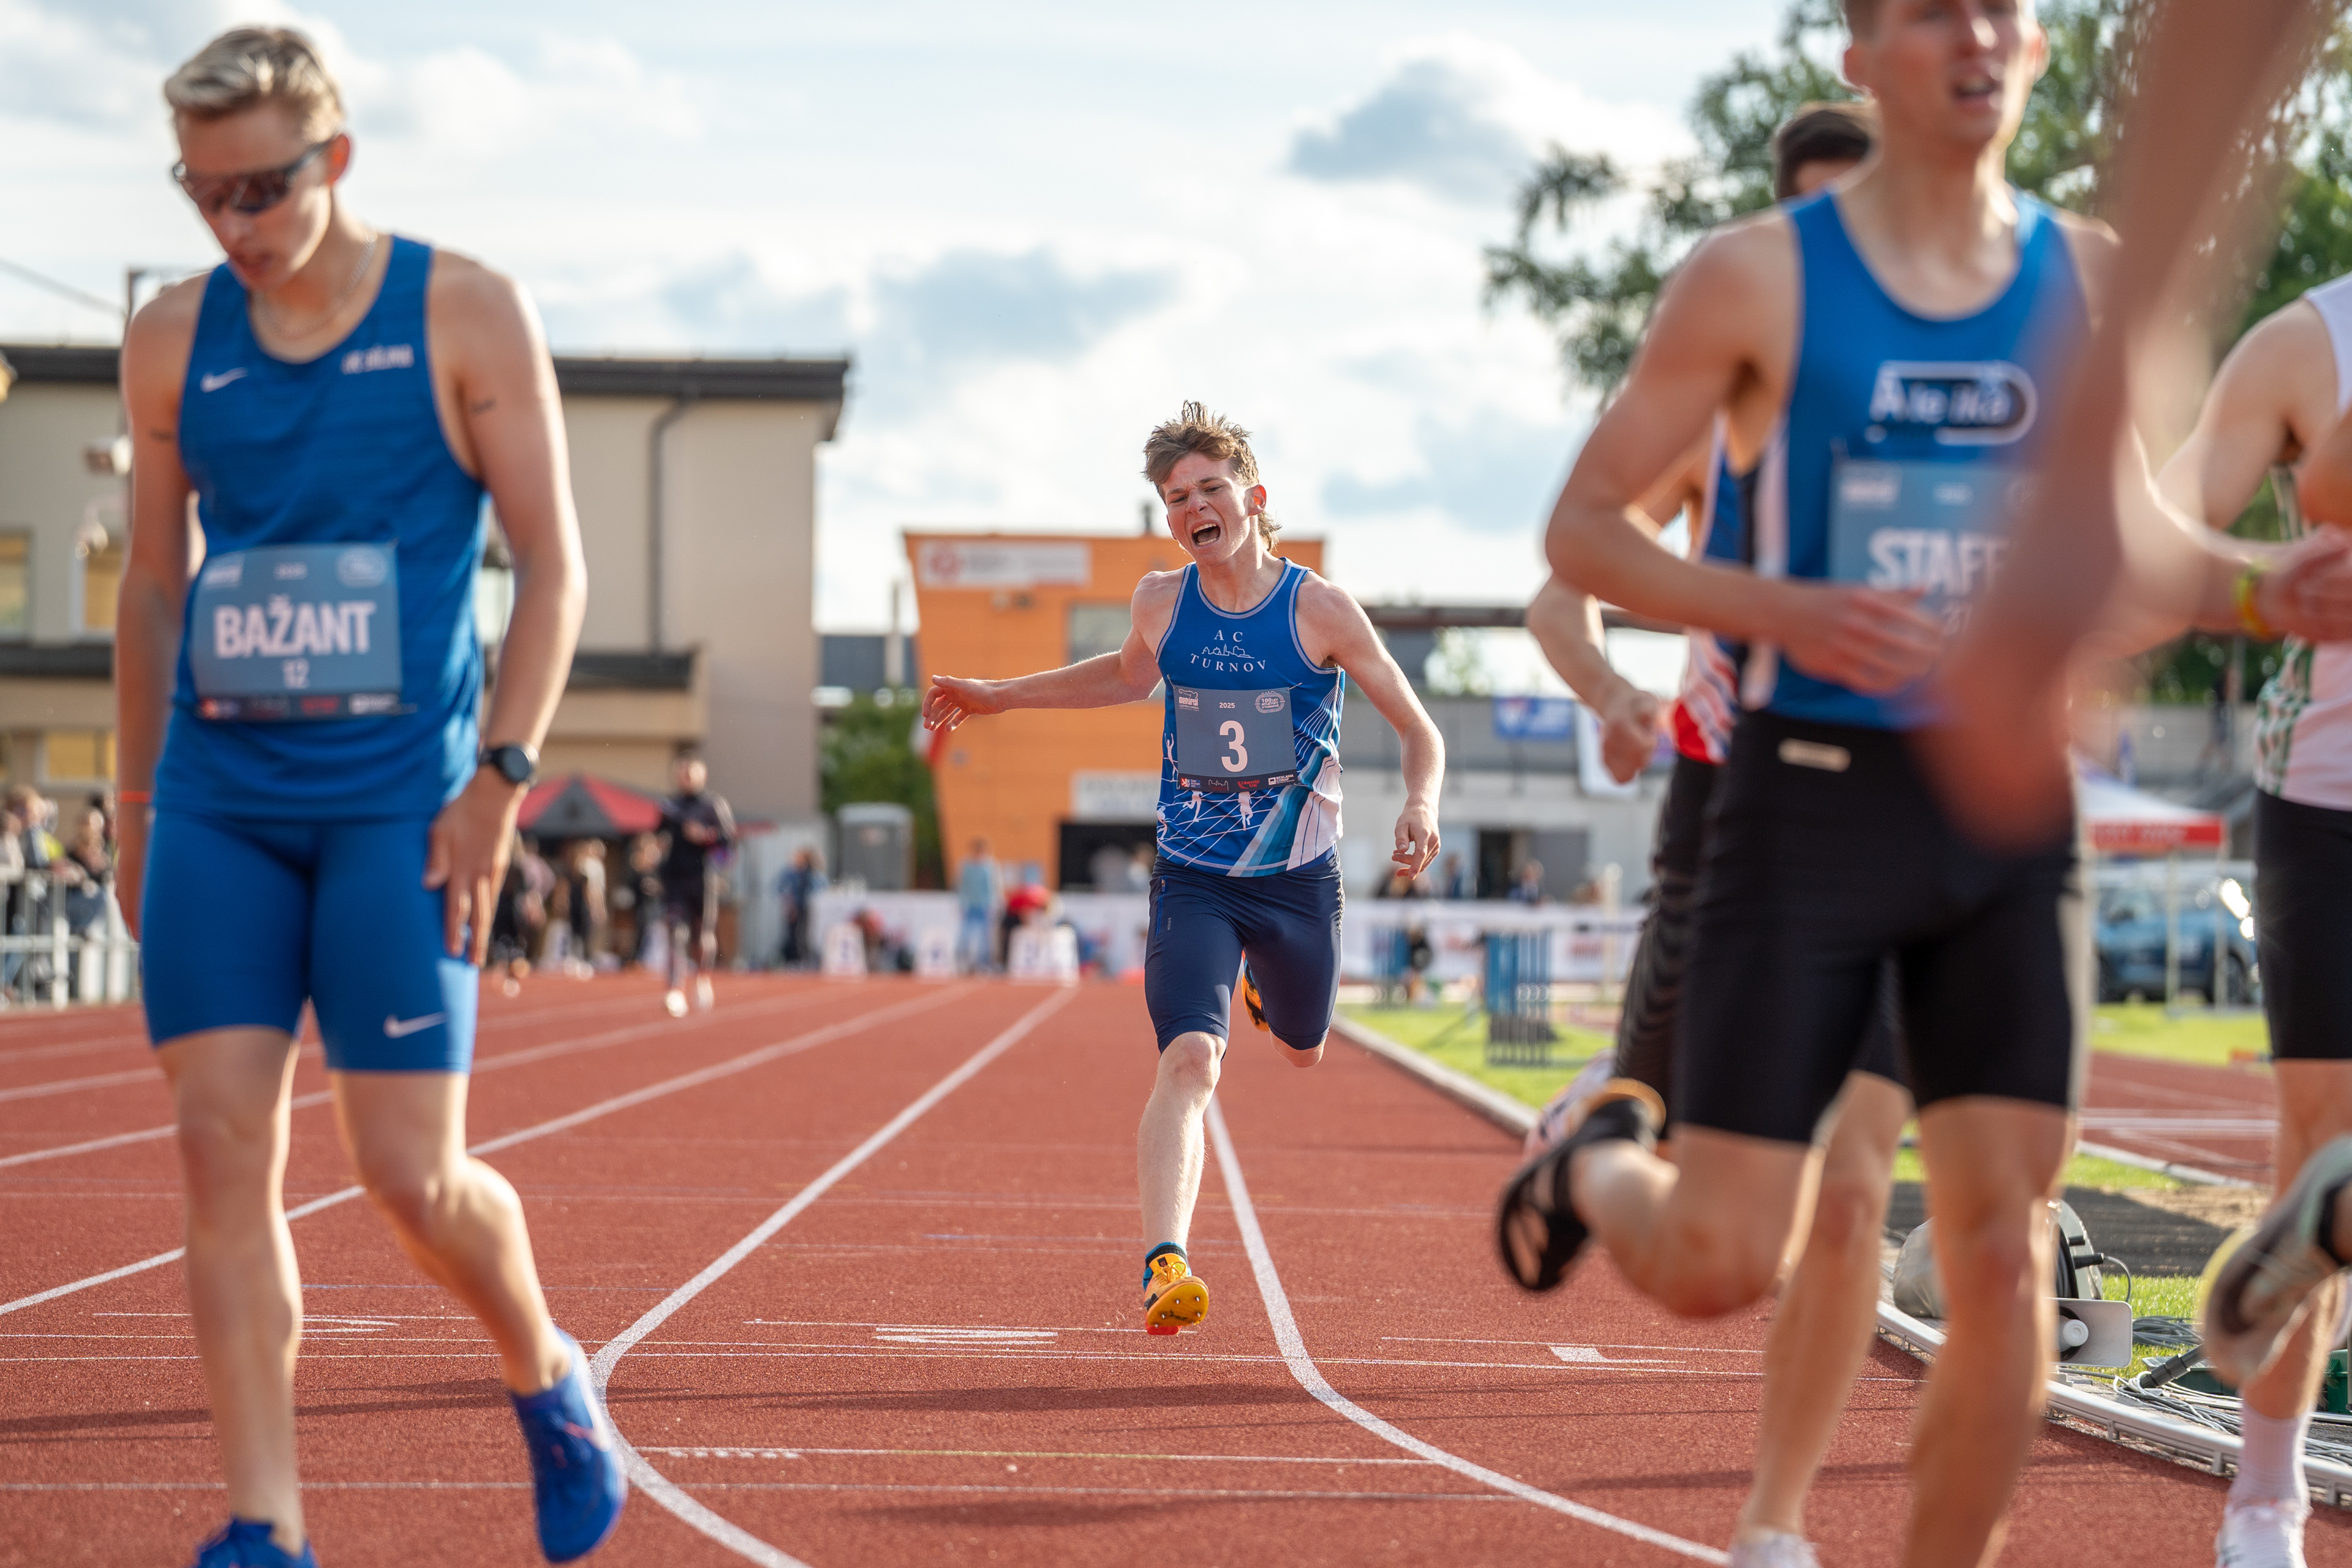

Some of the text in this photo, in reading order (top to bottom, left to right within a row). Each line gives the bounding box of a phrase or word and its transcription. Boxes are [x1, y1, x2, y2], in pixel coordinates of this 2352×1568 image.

[214, 593, 377, 660] BAŽANT
[1213, 629, 1243, 643] A C
[282, 657, 310, 690] 12
[1190, 653, 1266, 672] TURNOV
[1219, 720, 1248, 772] 3
